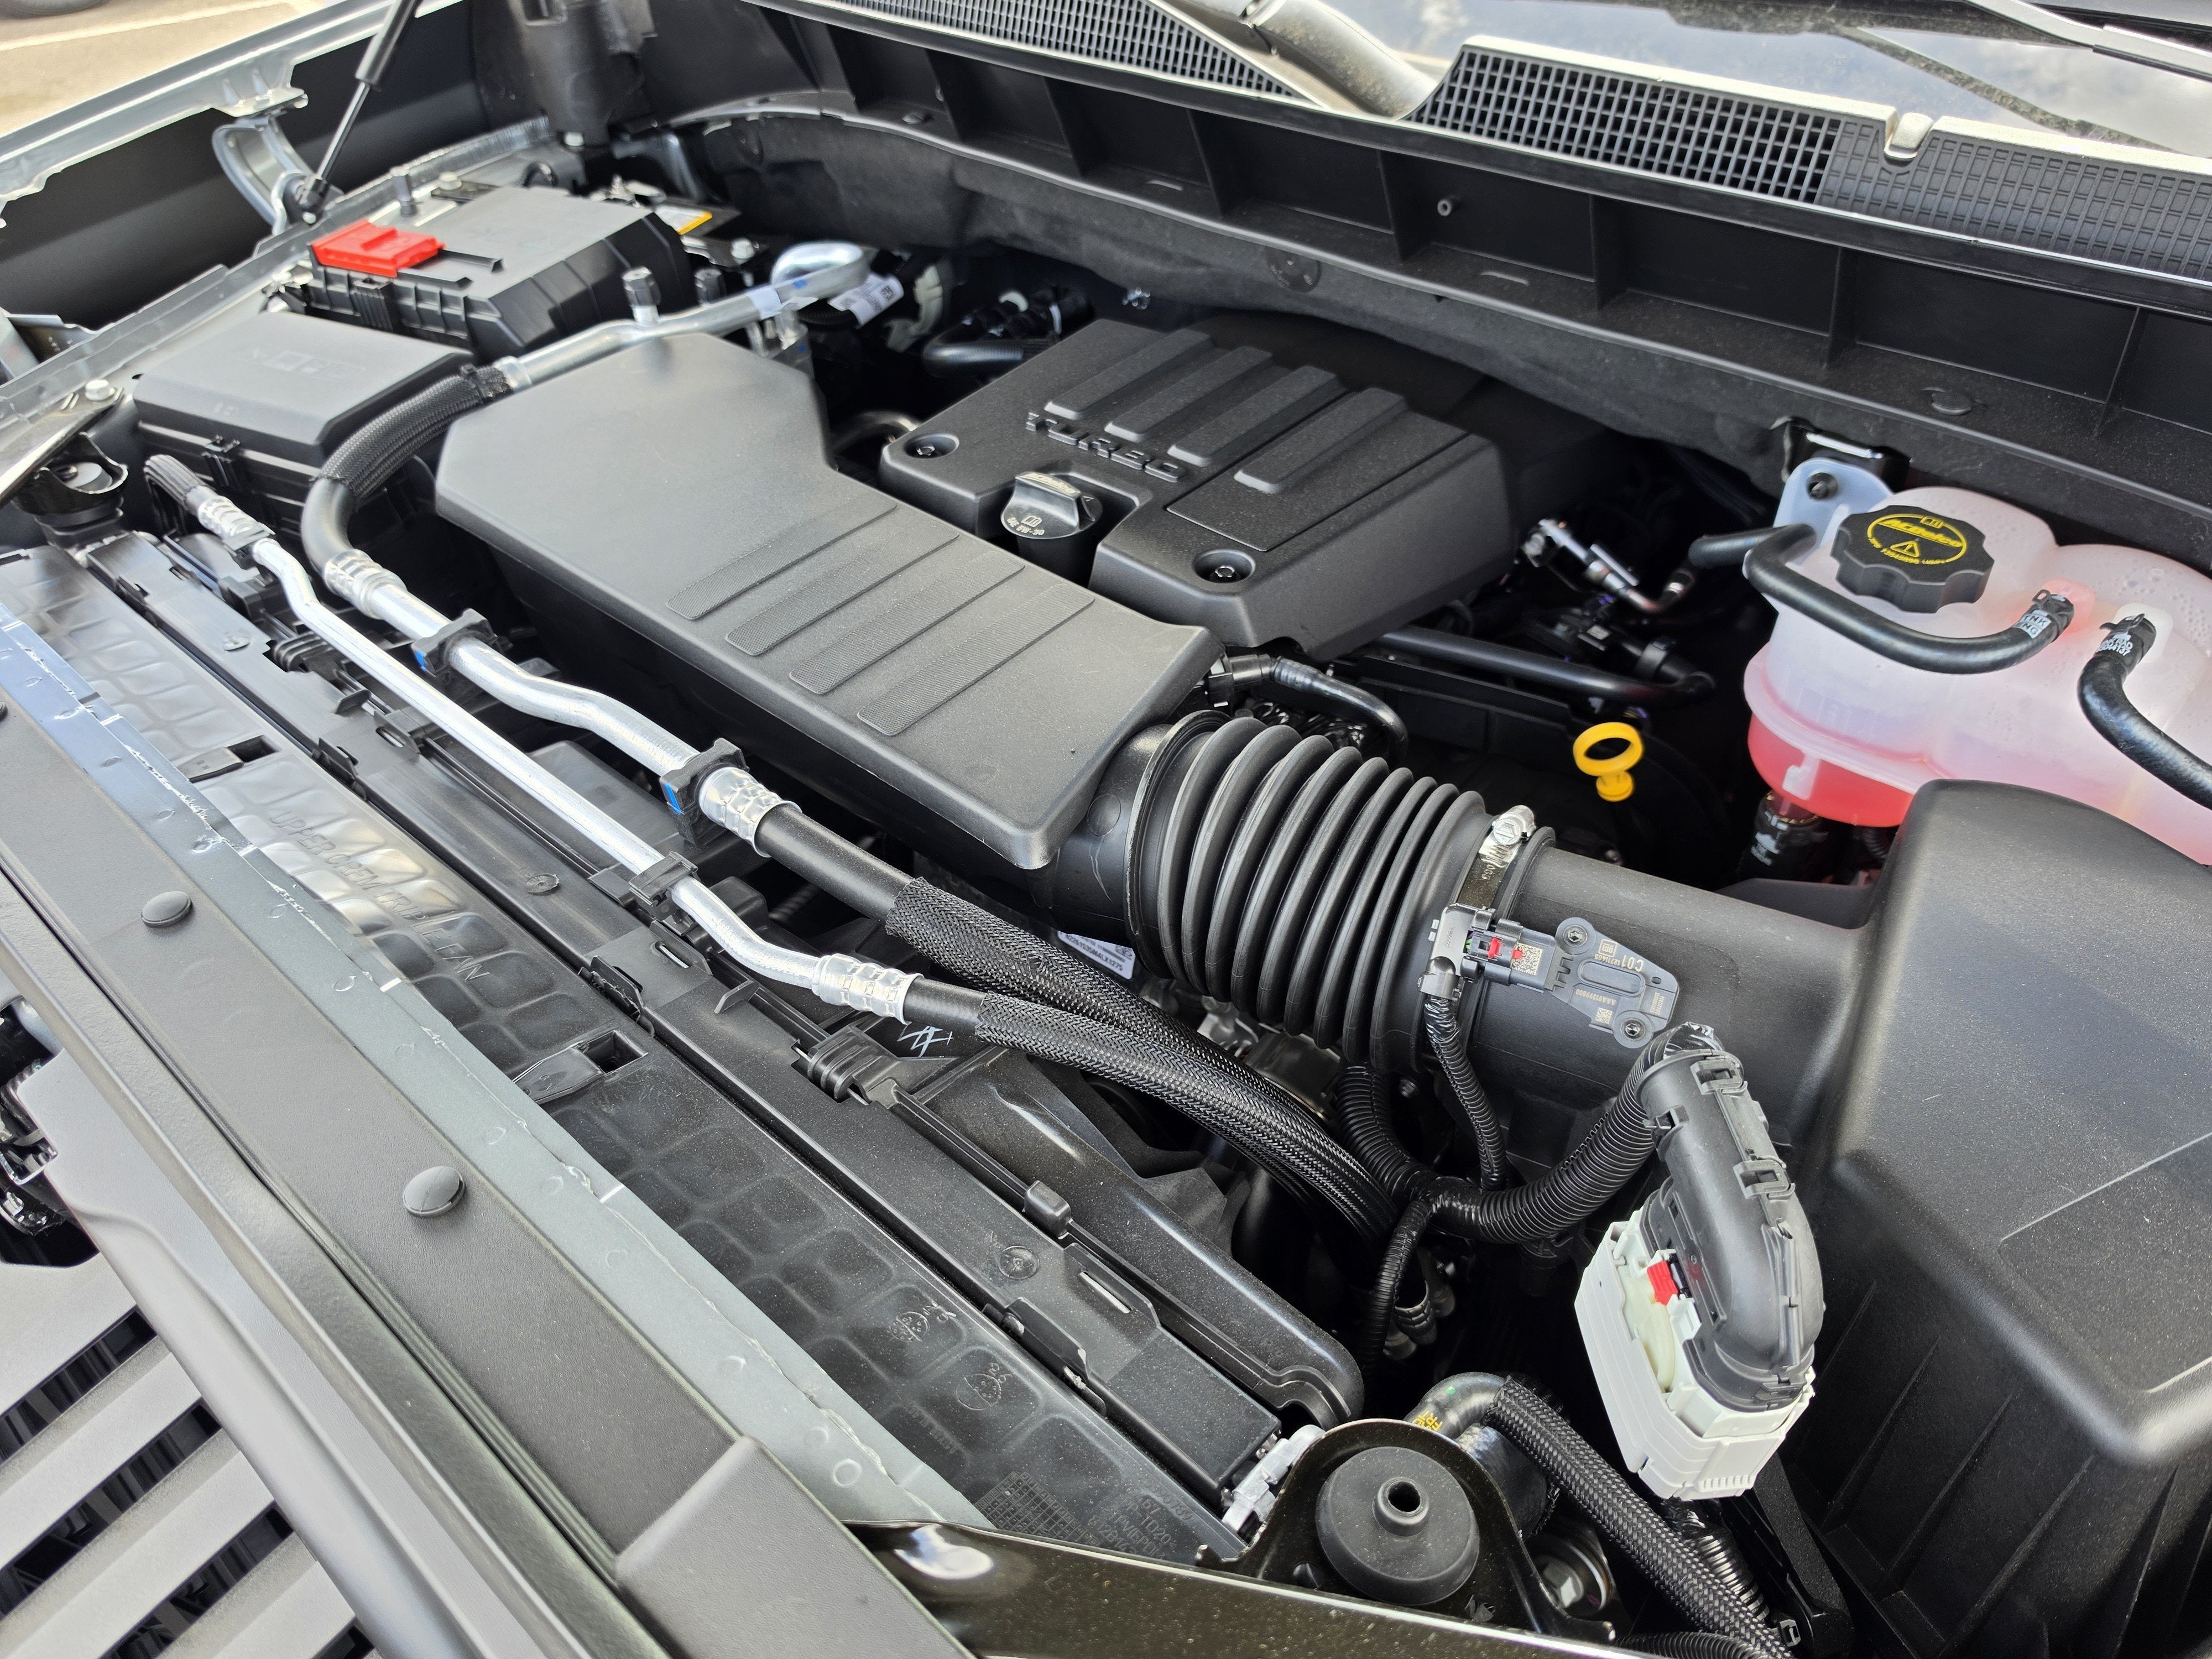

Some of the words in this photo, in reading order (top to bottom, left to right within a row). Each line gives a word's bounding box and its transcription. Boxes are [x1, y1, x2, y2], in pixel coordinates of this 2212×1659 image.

[1025, 409, 1187, 483] TURBO
[1006, 517, 1019, 528] SAE
[1879, 519, 1963, 547] ACDelco
[270, 811, 336, 855] UPPER
[375, 888, 452, 946] TRIPLE
[434, 943, 491, 983] FAN
[1594, 953, 1620, 966] 12711405
[1621, 954, 1644, 972] C01
